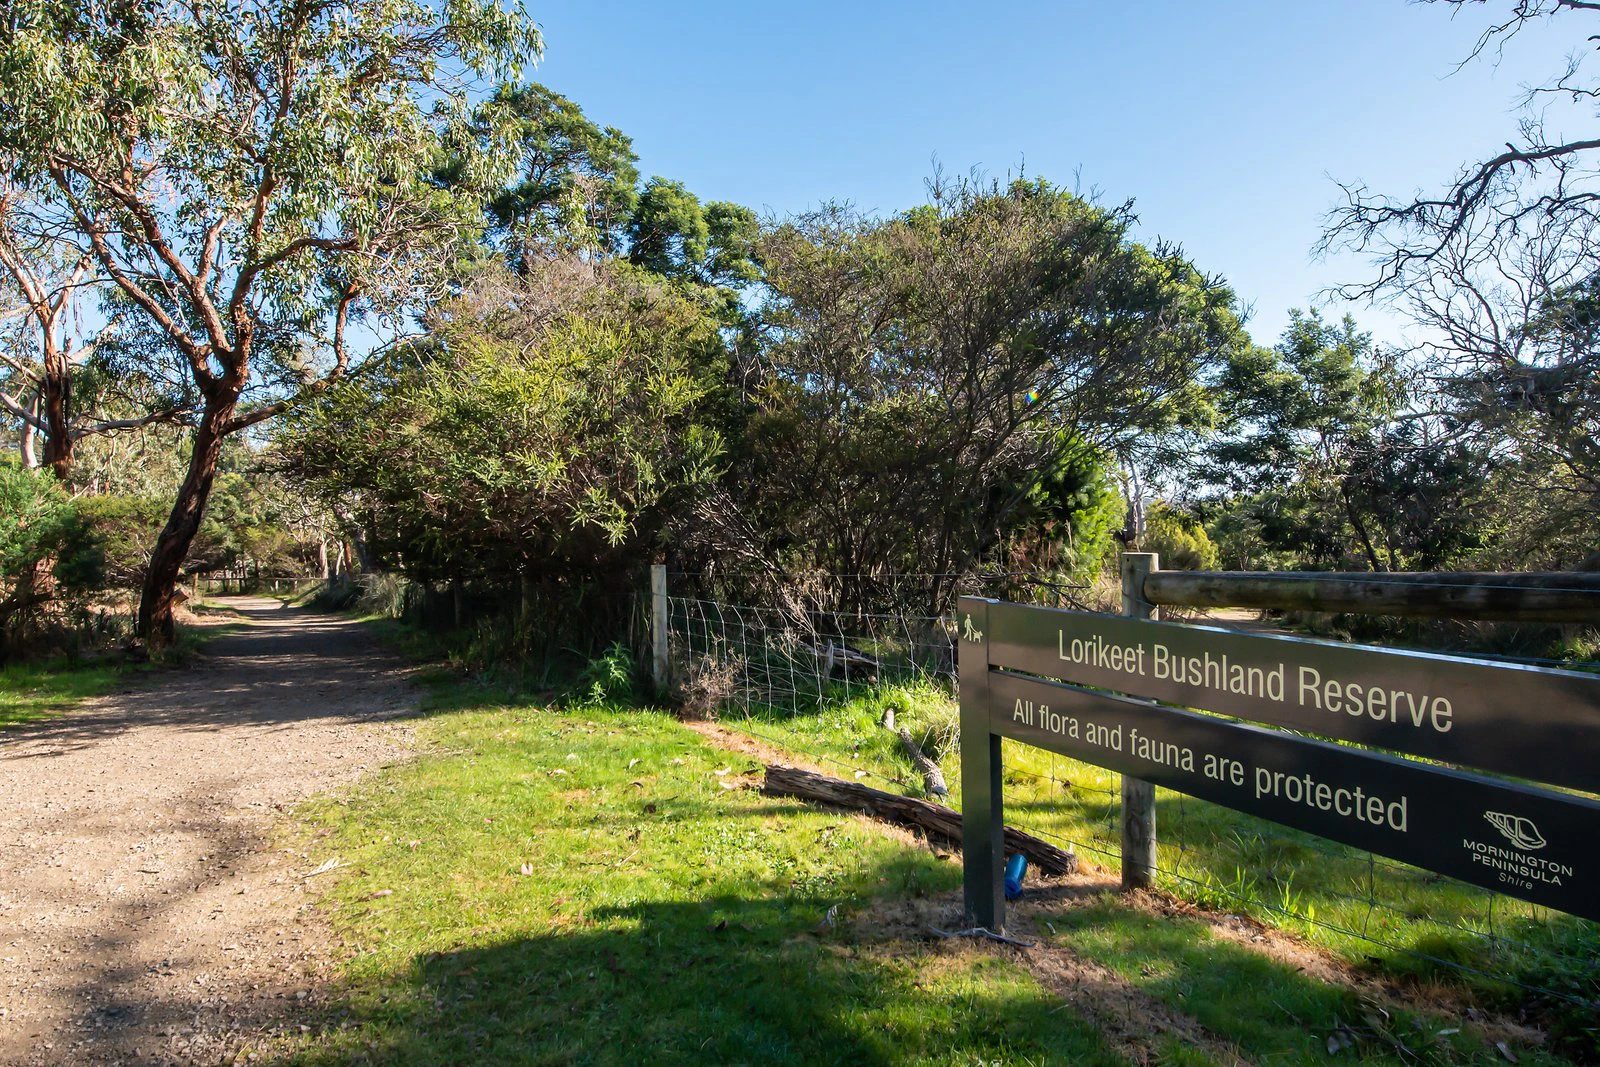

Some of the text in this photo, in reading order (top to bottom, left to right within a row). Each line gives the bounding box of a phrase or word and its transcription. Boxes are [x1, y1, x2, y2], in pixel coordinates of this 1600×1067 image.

[1060, 629, 1453, 733] Lorikeet Bushland Reserve
[1013, 698, 1408, 833] All flora and fauna are protected
[1463, 839, 1573, 877] MORNINGTON
[1473, 853, 1562, 886] PENINSULA
[1499, 872, 1533, 890] Shire
